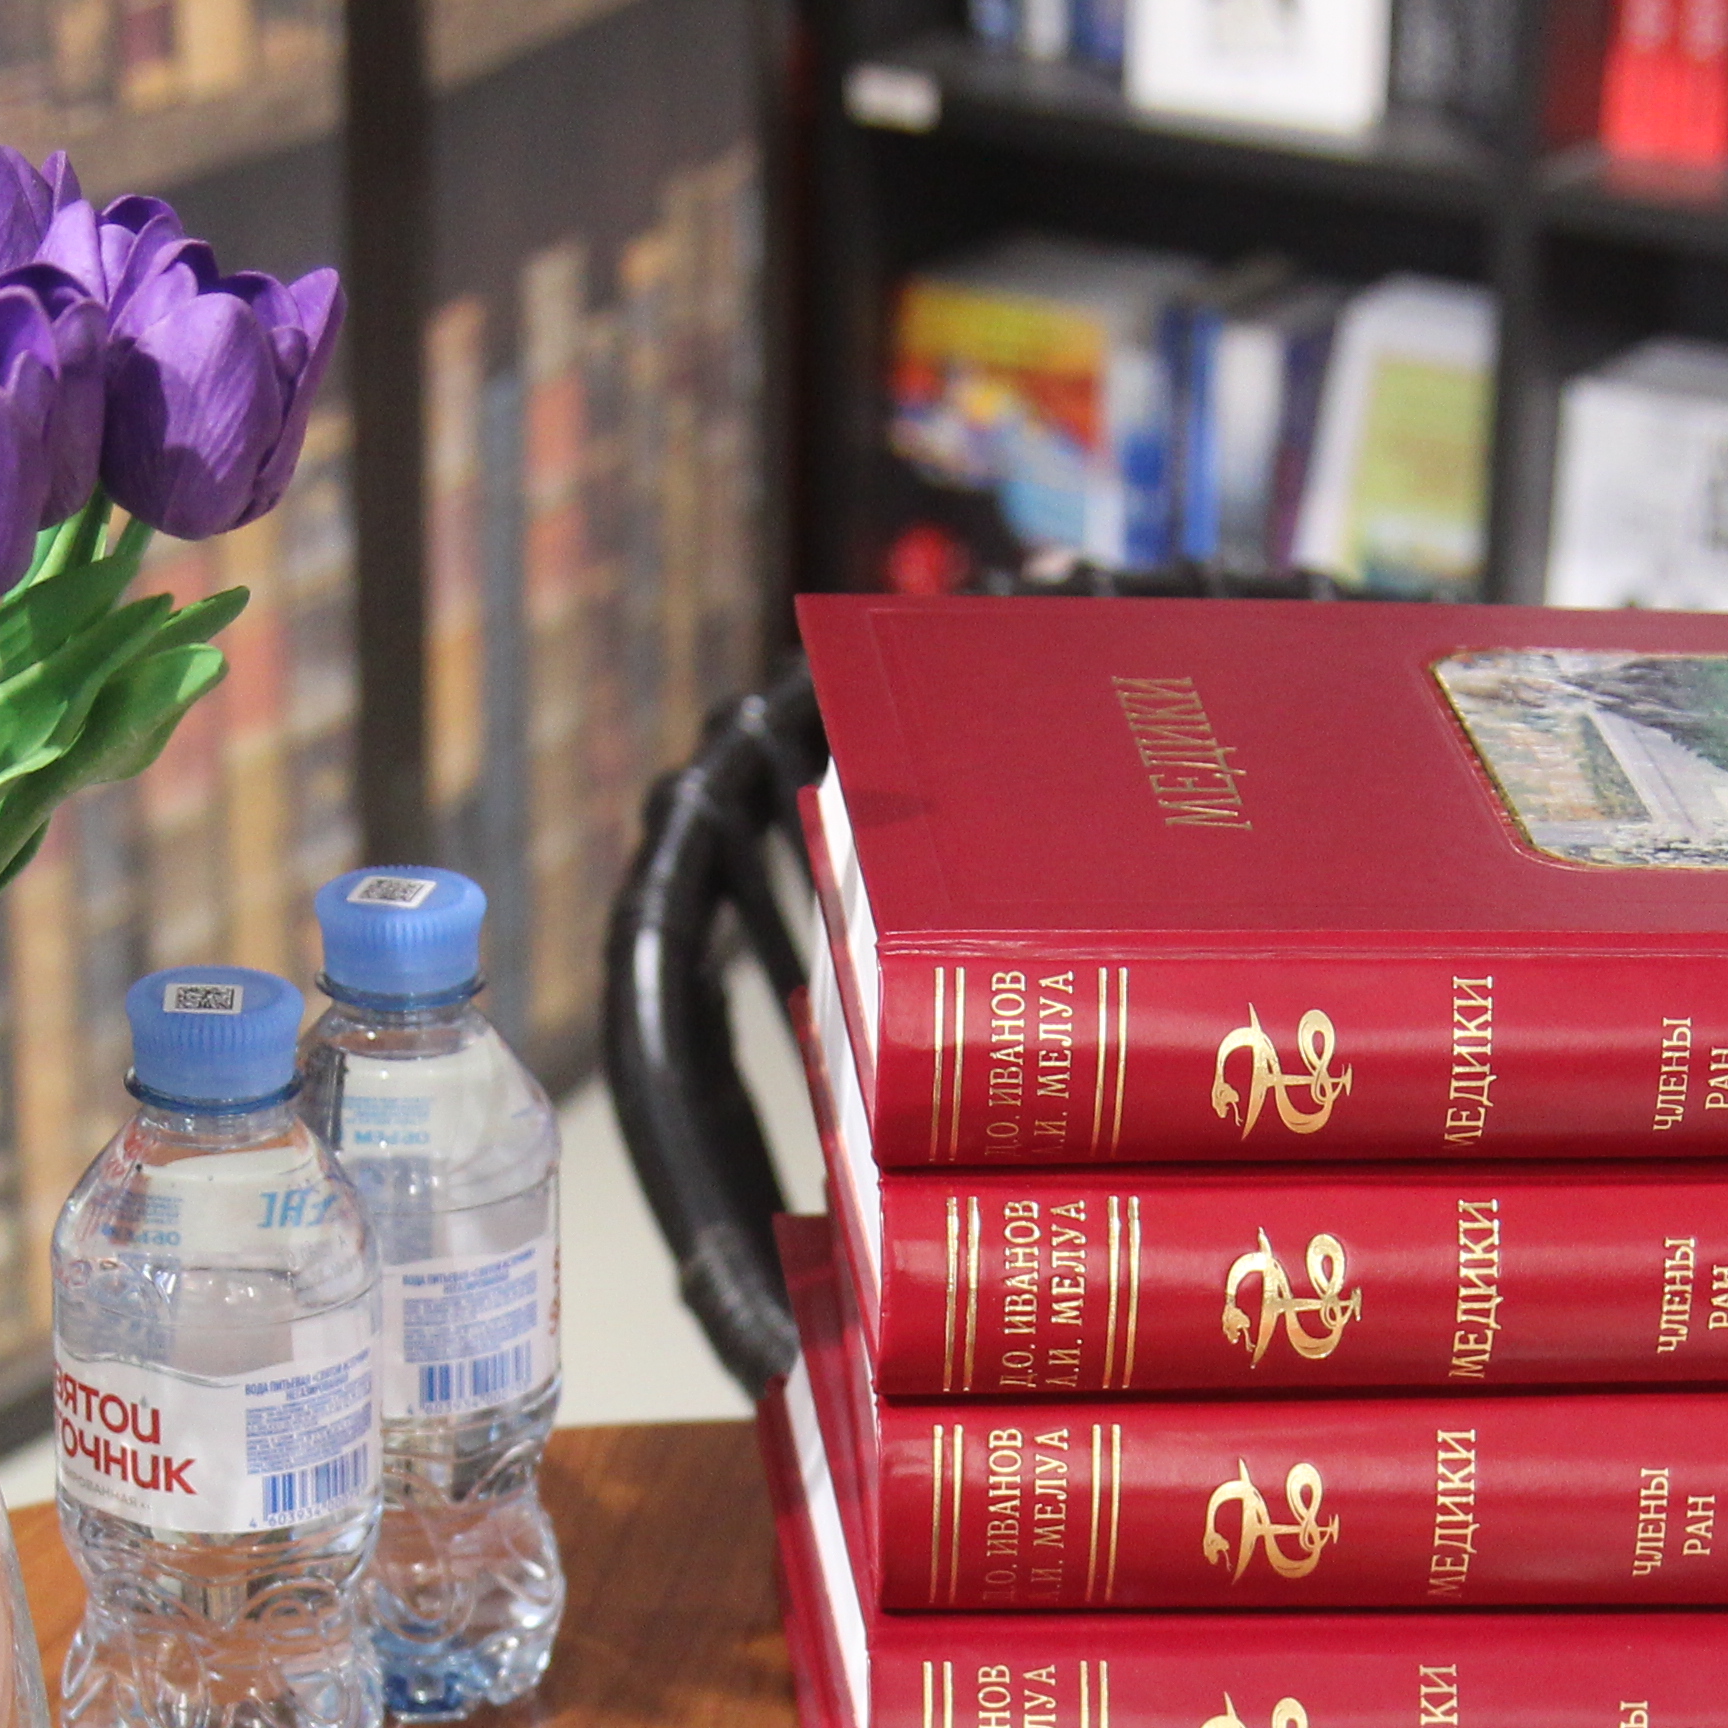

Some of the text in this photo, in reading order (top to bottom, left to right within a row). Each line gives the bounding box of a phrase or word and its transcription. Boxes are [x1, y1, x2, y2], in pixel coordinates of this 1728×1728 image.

[1111, 676, 1253, 831] МЕДИКИ
[991, 969, 1025, 1104] ИВАНОВ
[1039, 970, 1075, 1100] МЕЛУА
[1444, 974, 1496, 1150] МЕДИКИ
[1653, 1016, 1692, 1132] ЧЛЕНЫ
[1004, 1200, 1040, 1333] ИВАНОВ
[1052, 1200, 1085, 1326] МЕЛУА
[1449, 1199, 1503, 1381] МЕДИКИ
[1657, 1236, 1695, 1354] ЧЛЕНЫ
[60, 1417, 198, 1495] ОЧНИК
[986, 1429, 1023, 1552] ИВАНОВ
[1034, 1427, 1069, 1548] МЕЛУА
[1428, 1429, 1479, 1599] МЕДИКИ
[1632, 1468, 1669, 1579] ЧЛЕНЫ
[1683, 1494, 1716, 1558] РАН
